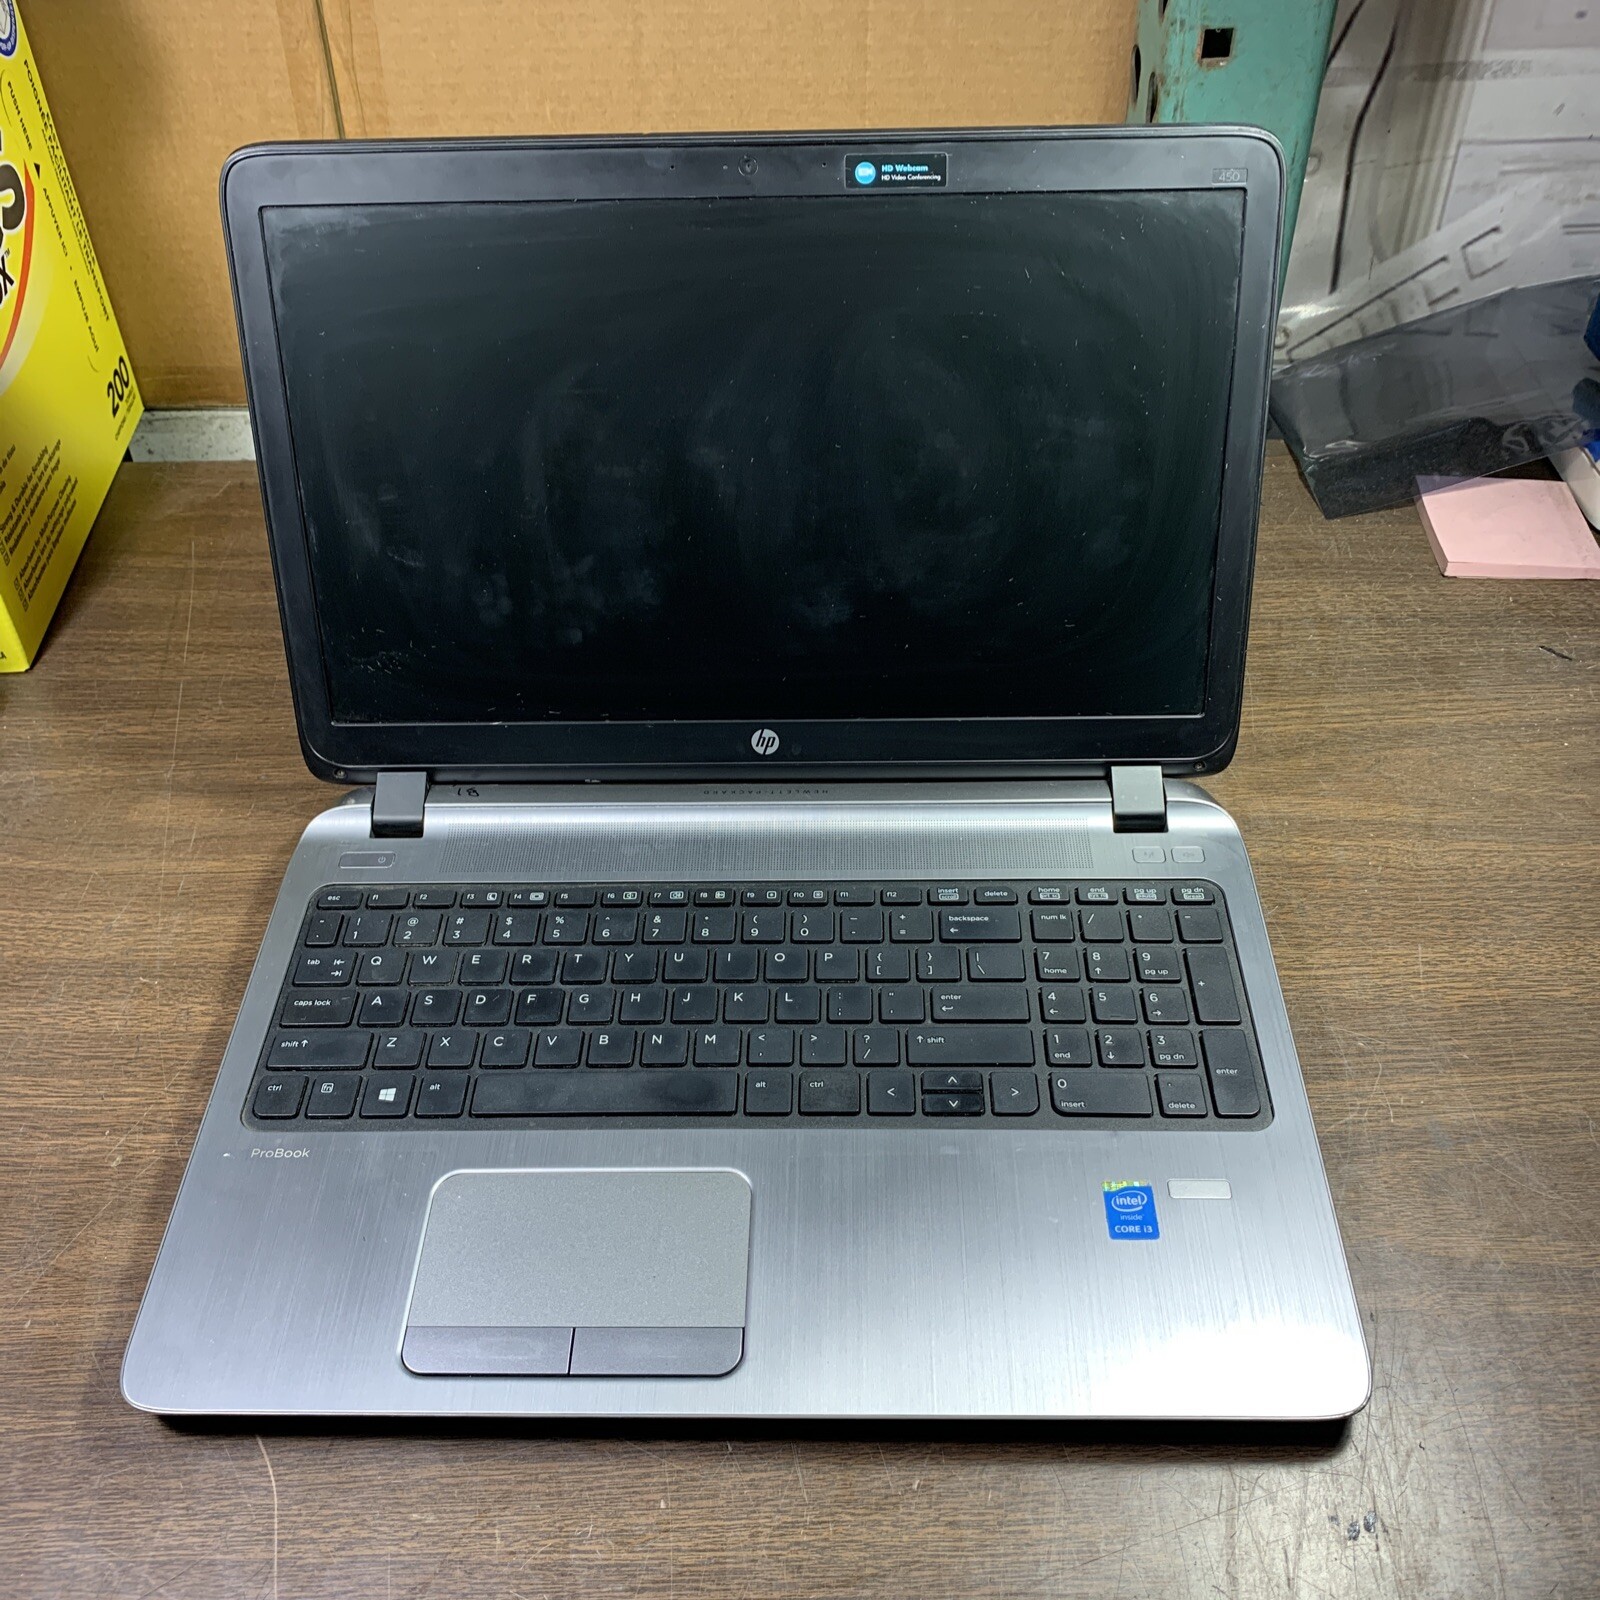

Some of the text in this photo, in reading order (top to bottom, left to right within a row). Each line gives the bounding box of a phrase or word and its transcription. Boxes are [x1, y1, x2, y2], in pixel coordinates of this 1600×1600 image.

[6, 80, 33, 150] PUSH HERE
[895, 164, 929, 172] Webcam
[1219, 171, 1240, 181] 450
[23, 59, 49, 130] POIGNÉE
[47, 134, 77, 216] FACILITANT
[75, 221, 83, 239] LE
[83, 240, 110, 322] TRANSPORT
[42, 188, 62, 239] APPUYER
[73, 279, 89, 323] EMPUJE
[107, 355, 129, 418] 200
[754, 728, 778, 755] hp
[408, 918, 418, 926] @
[506, 917, 512, 925] $
[354, 931, 357, 939] 1
[404, 931, 411, 939] 2
[503, 930, 510, 938] 4
[603, 929, 609, 937] 6
[751, 928, 758, 936] 9
[423, 956, 437, 964] W
[472, 955, 481, 964] E
[522, 955, 531, 963] R
[575, 954, 582, 963] T
[625, 954, 633, 962] Y
[675, 953, 683, 961] U
[825, 953, 833, 961] P
[1043, 952, 1049, 960] 7
[1093, 952, 1100, 960] 8
[1142, 953, 1150, 961] 9
[371, 956, 381, 965] Q
[372, 996, 381, 1005] A
[425, 996, 433, 1005] S
[476, 995, 486, 1004] D
[527, 995, 536, 1003] F
[579, 994, 589, 1003] G
[631, 993, 640, 1002] H
[683, 993, 690, 1001] J
[734, 993, 743, 1001] K
[786, 993, 793, 1001] L
[1099, 993, 1106, 1001] 5
[1150, 993, 1158, 1002] 6
[387, 1038, 397, 1047] Z
[440, 1037, 450, 1046] X
[494, 1037, 504, 1046] C
[548, 1036, 557, 1045] V
[599, 1035, 608, 1044] B
[652, 1035, 662, 1044] N
[705, 1035, 716, 1043] M
[864, 1035, 870, 1043] ?
[1054, 1035, 1058, 1043] 1
[1105, 1035, 1112, 1044] 2
[1158, 1036, 1165, 1044] 3
[251, 1148, 310, 1158] ProBook
[1115, 1195, 1142, 1206] intel
[1115, 1225, 1153, 1233] CORE i3
